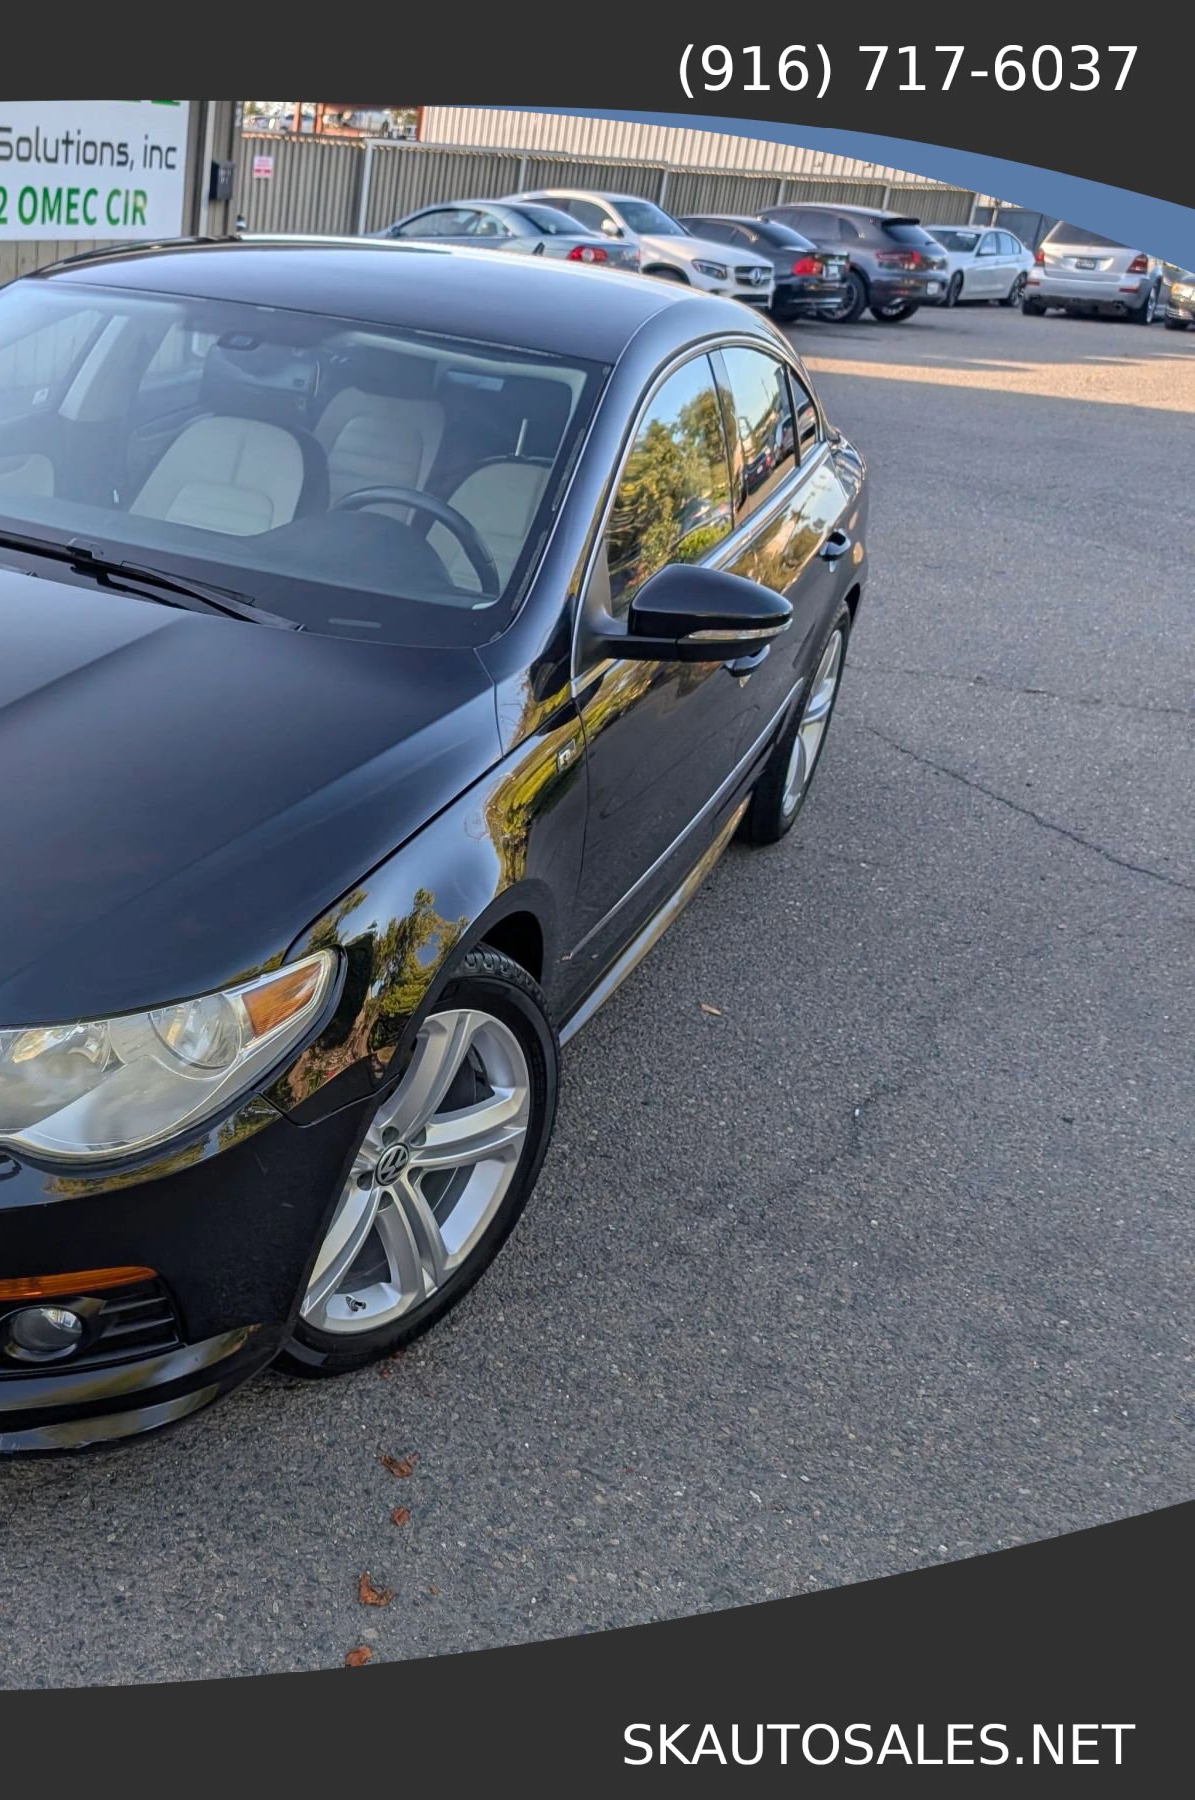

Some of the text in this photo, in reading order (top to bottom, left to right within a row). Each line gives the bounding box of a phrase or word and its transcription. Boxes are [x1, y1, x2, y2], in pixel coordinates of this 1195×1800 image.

[142, 134, 177, 170] inc
[17, 185, 98, 226] OMEC
[106, 188, 148, 226] CIR
